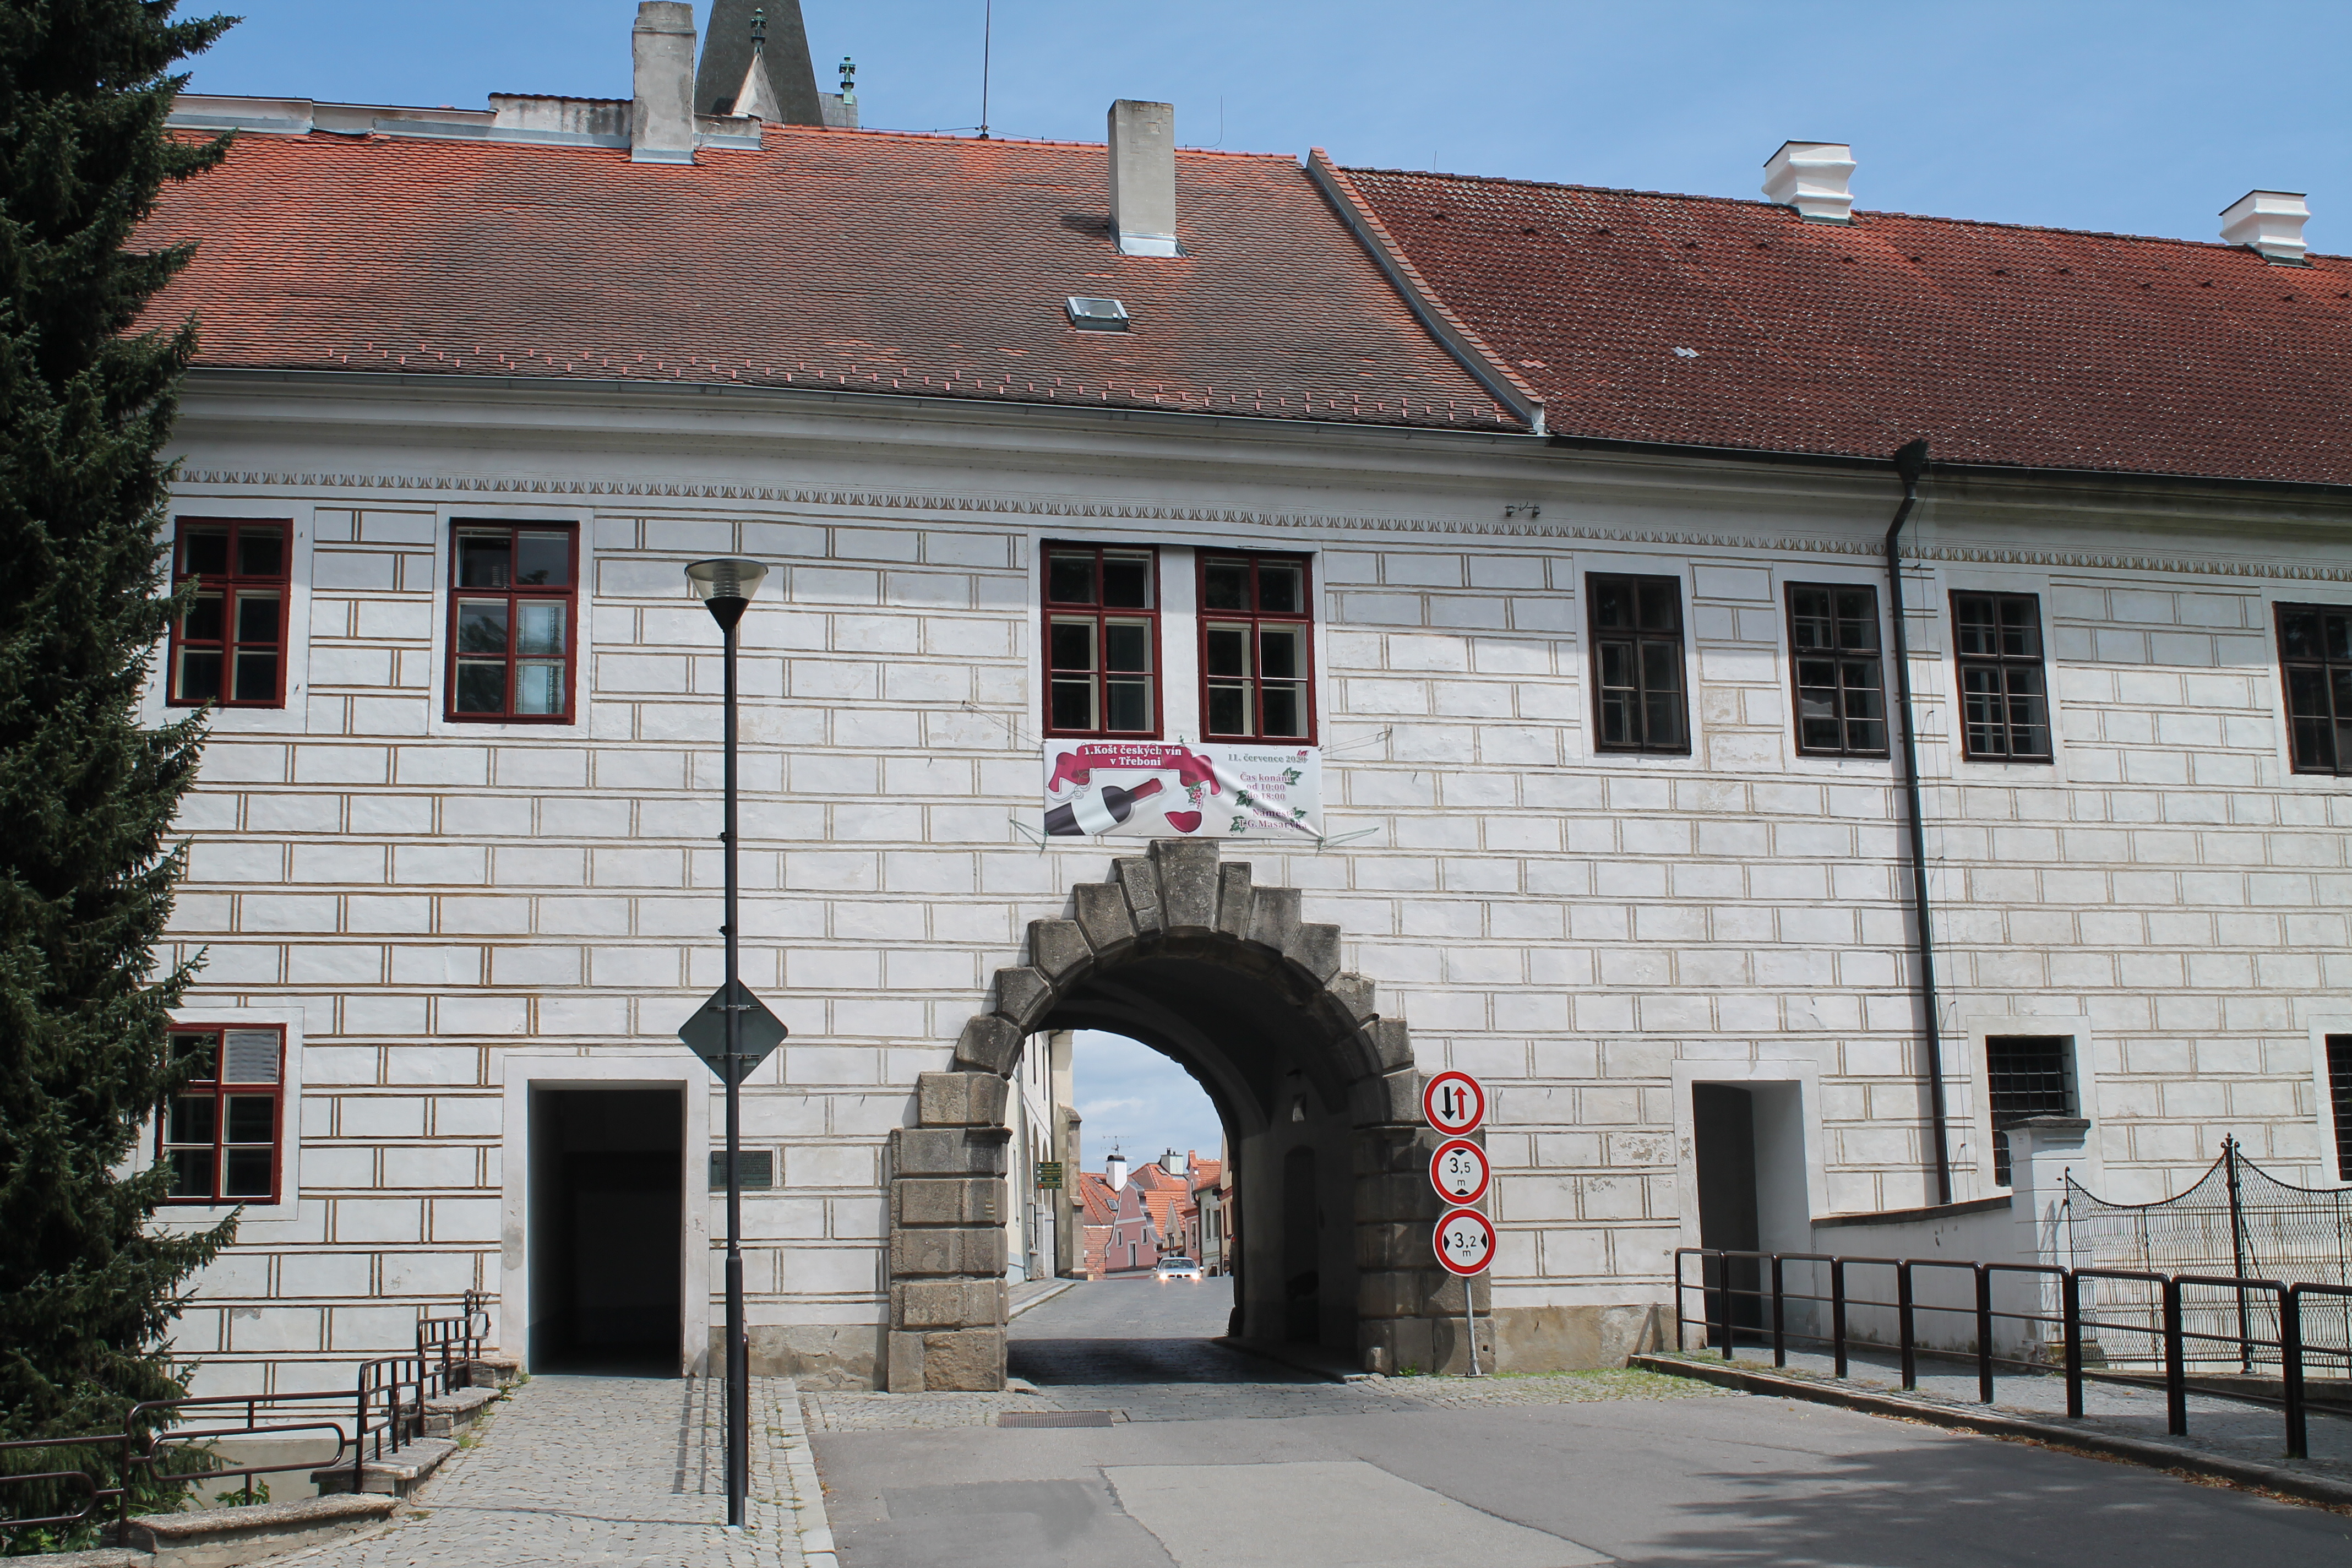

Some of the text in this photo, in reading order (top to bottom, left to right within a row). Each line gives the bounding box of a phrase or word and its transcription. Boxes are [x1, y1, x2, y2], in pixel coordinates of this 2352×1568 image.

[1085, 744, 1182, 757] 1.Košt českých vín
[1119, 756, 1161, 766] Třeboni
[1243, 753, 1283, 762] července
[1240, 771, 1291, 782] Čas konání
[1253, 808, 1295, 817] Náměstí
[1450, 1157, 1471, 1174] 3,5
[1454, 1232, 1477, 1249] 3,2
